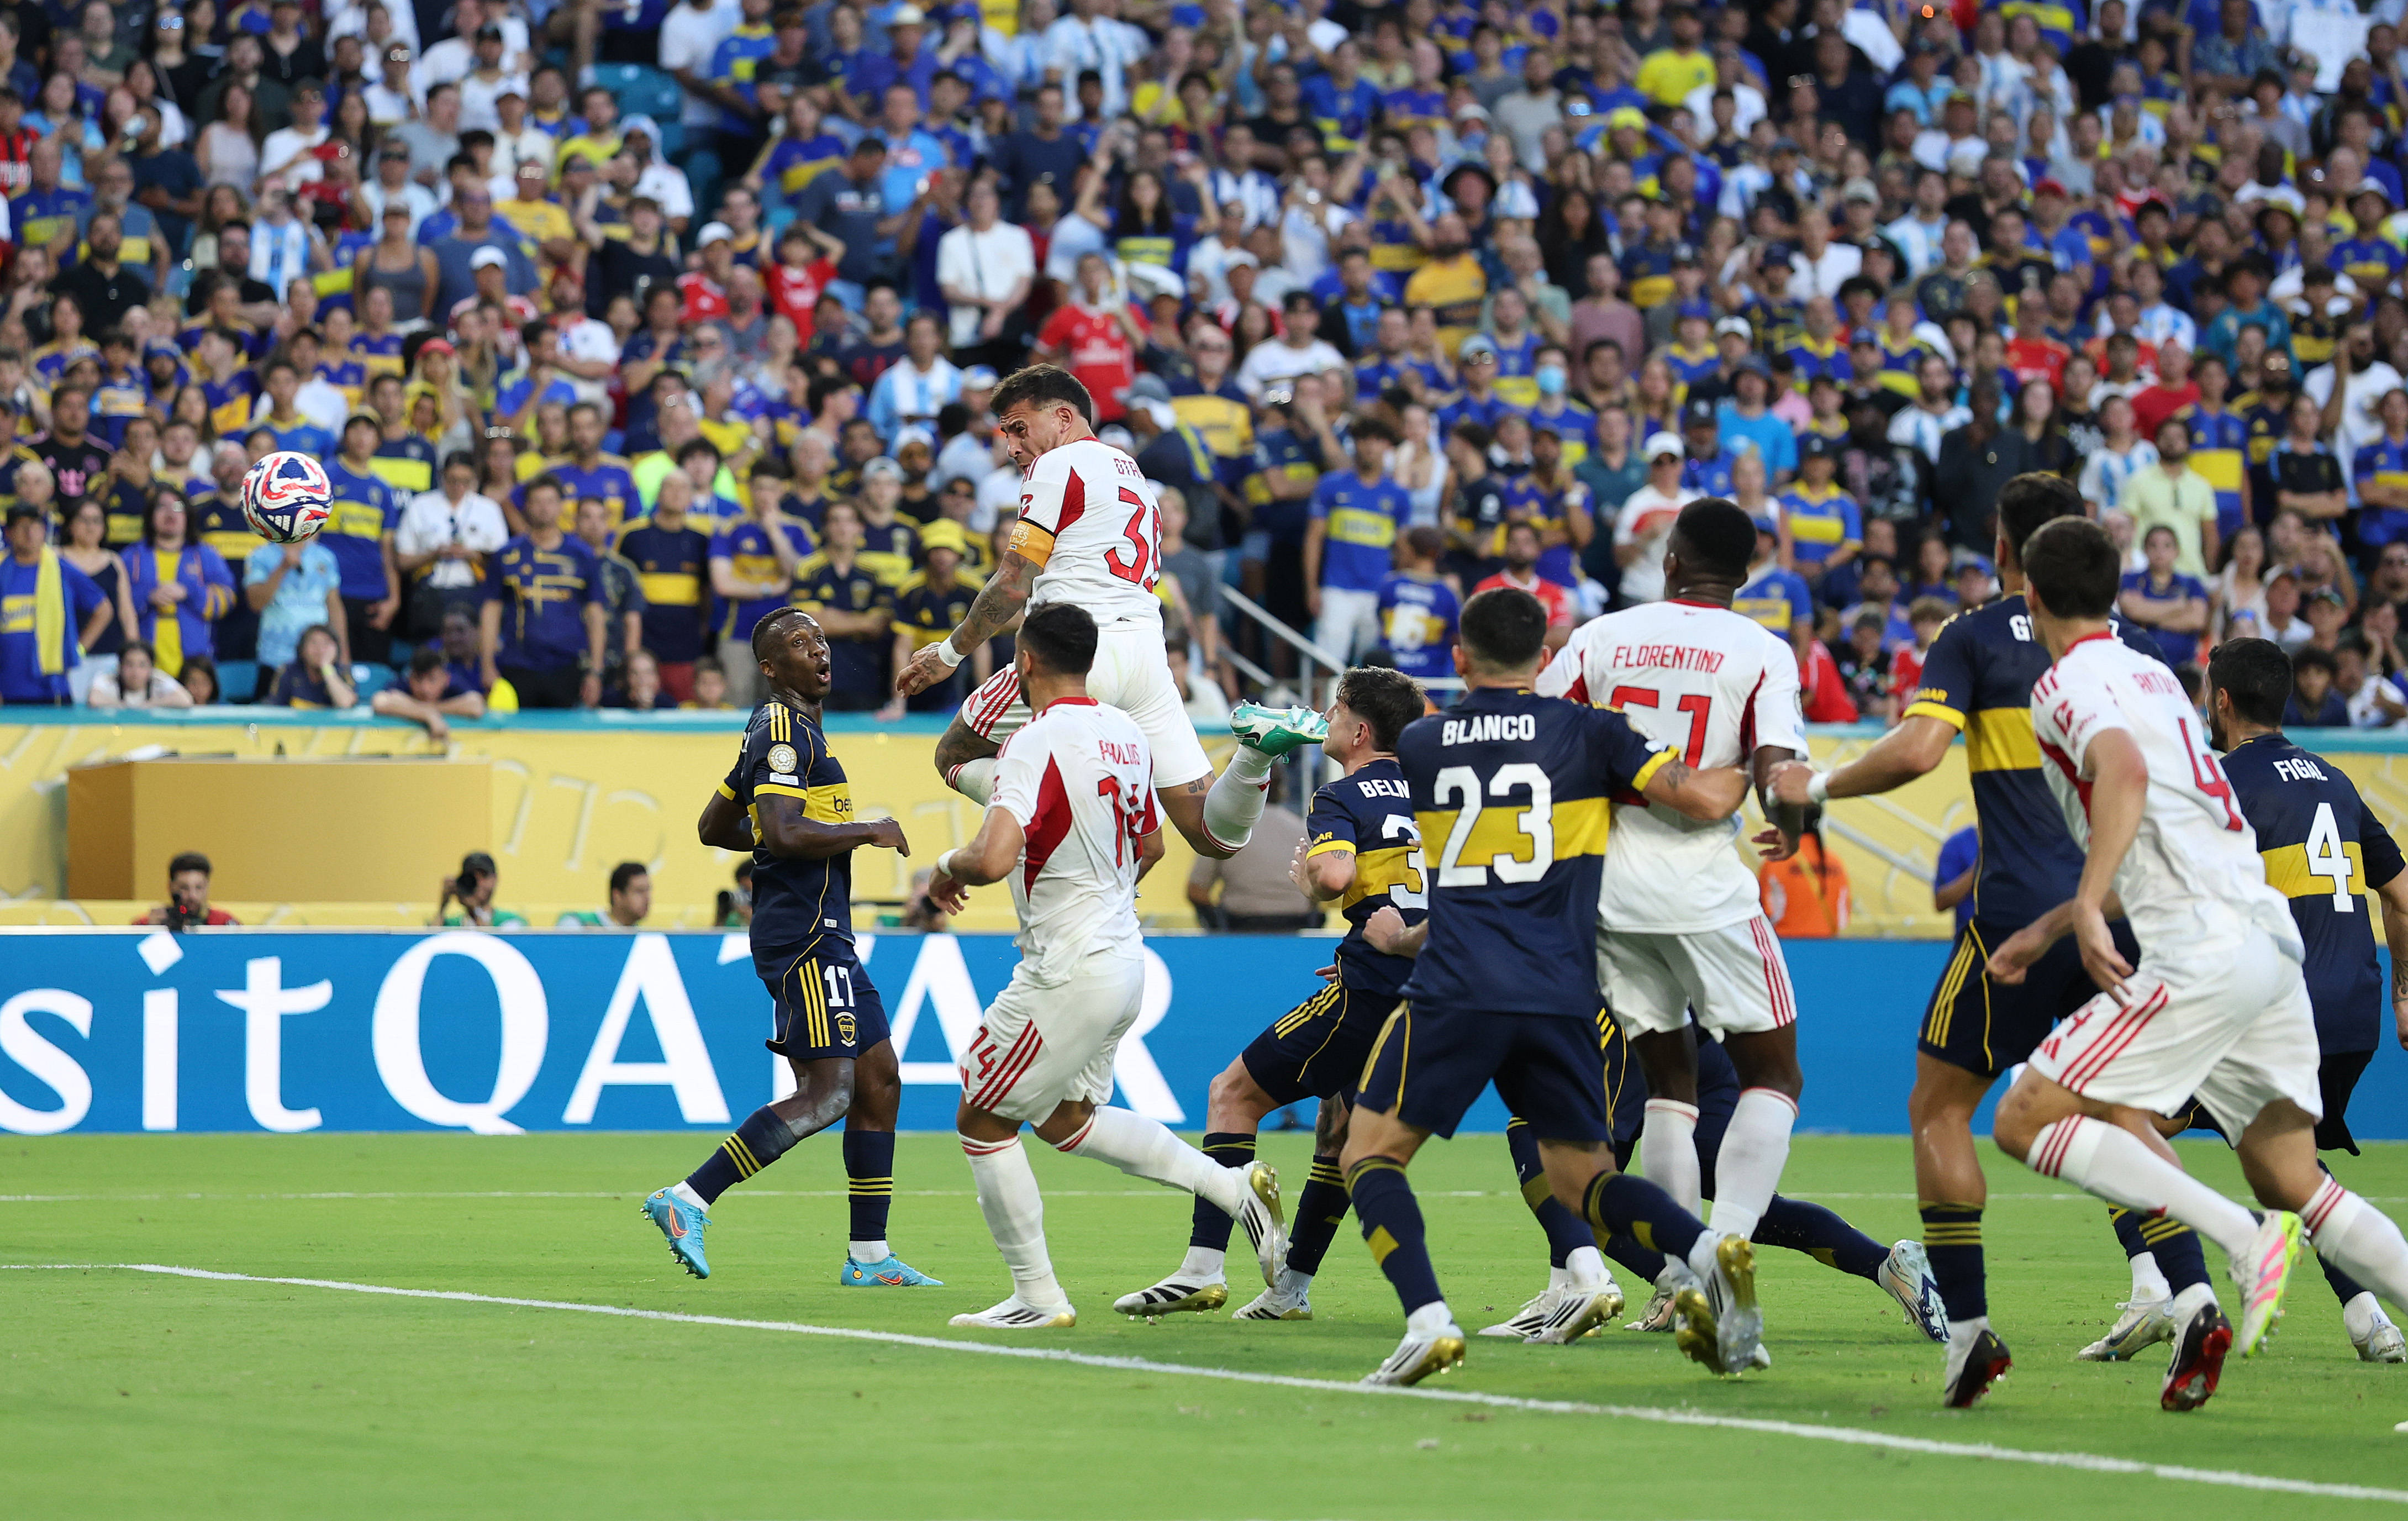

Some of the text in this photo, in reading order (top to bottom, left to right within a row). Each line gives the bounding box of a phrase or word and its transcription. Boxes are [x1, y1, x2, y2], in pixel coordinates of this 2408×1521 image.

[1613, 645, 1725, 674] FLORENTINO
[1441, 713, 1536, 746] BLANCO
[2177, 718, 2243, 832] 4
[2273, 758, 2328, 782] FIGAL
[1433, 763, 1555, 887] 23
[2304, 802, 2354, 913] 4
[824, 965, 855, 1007] 17
[0, 931, 333, 1136] sit
